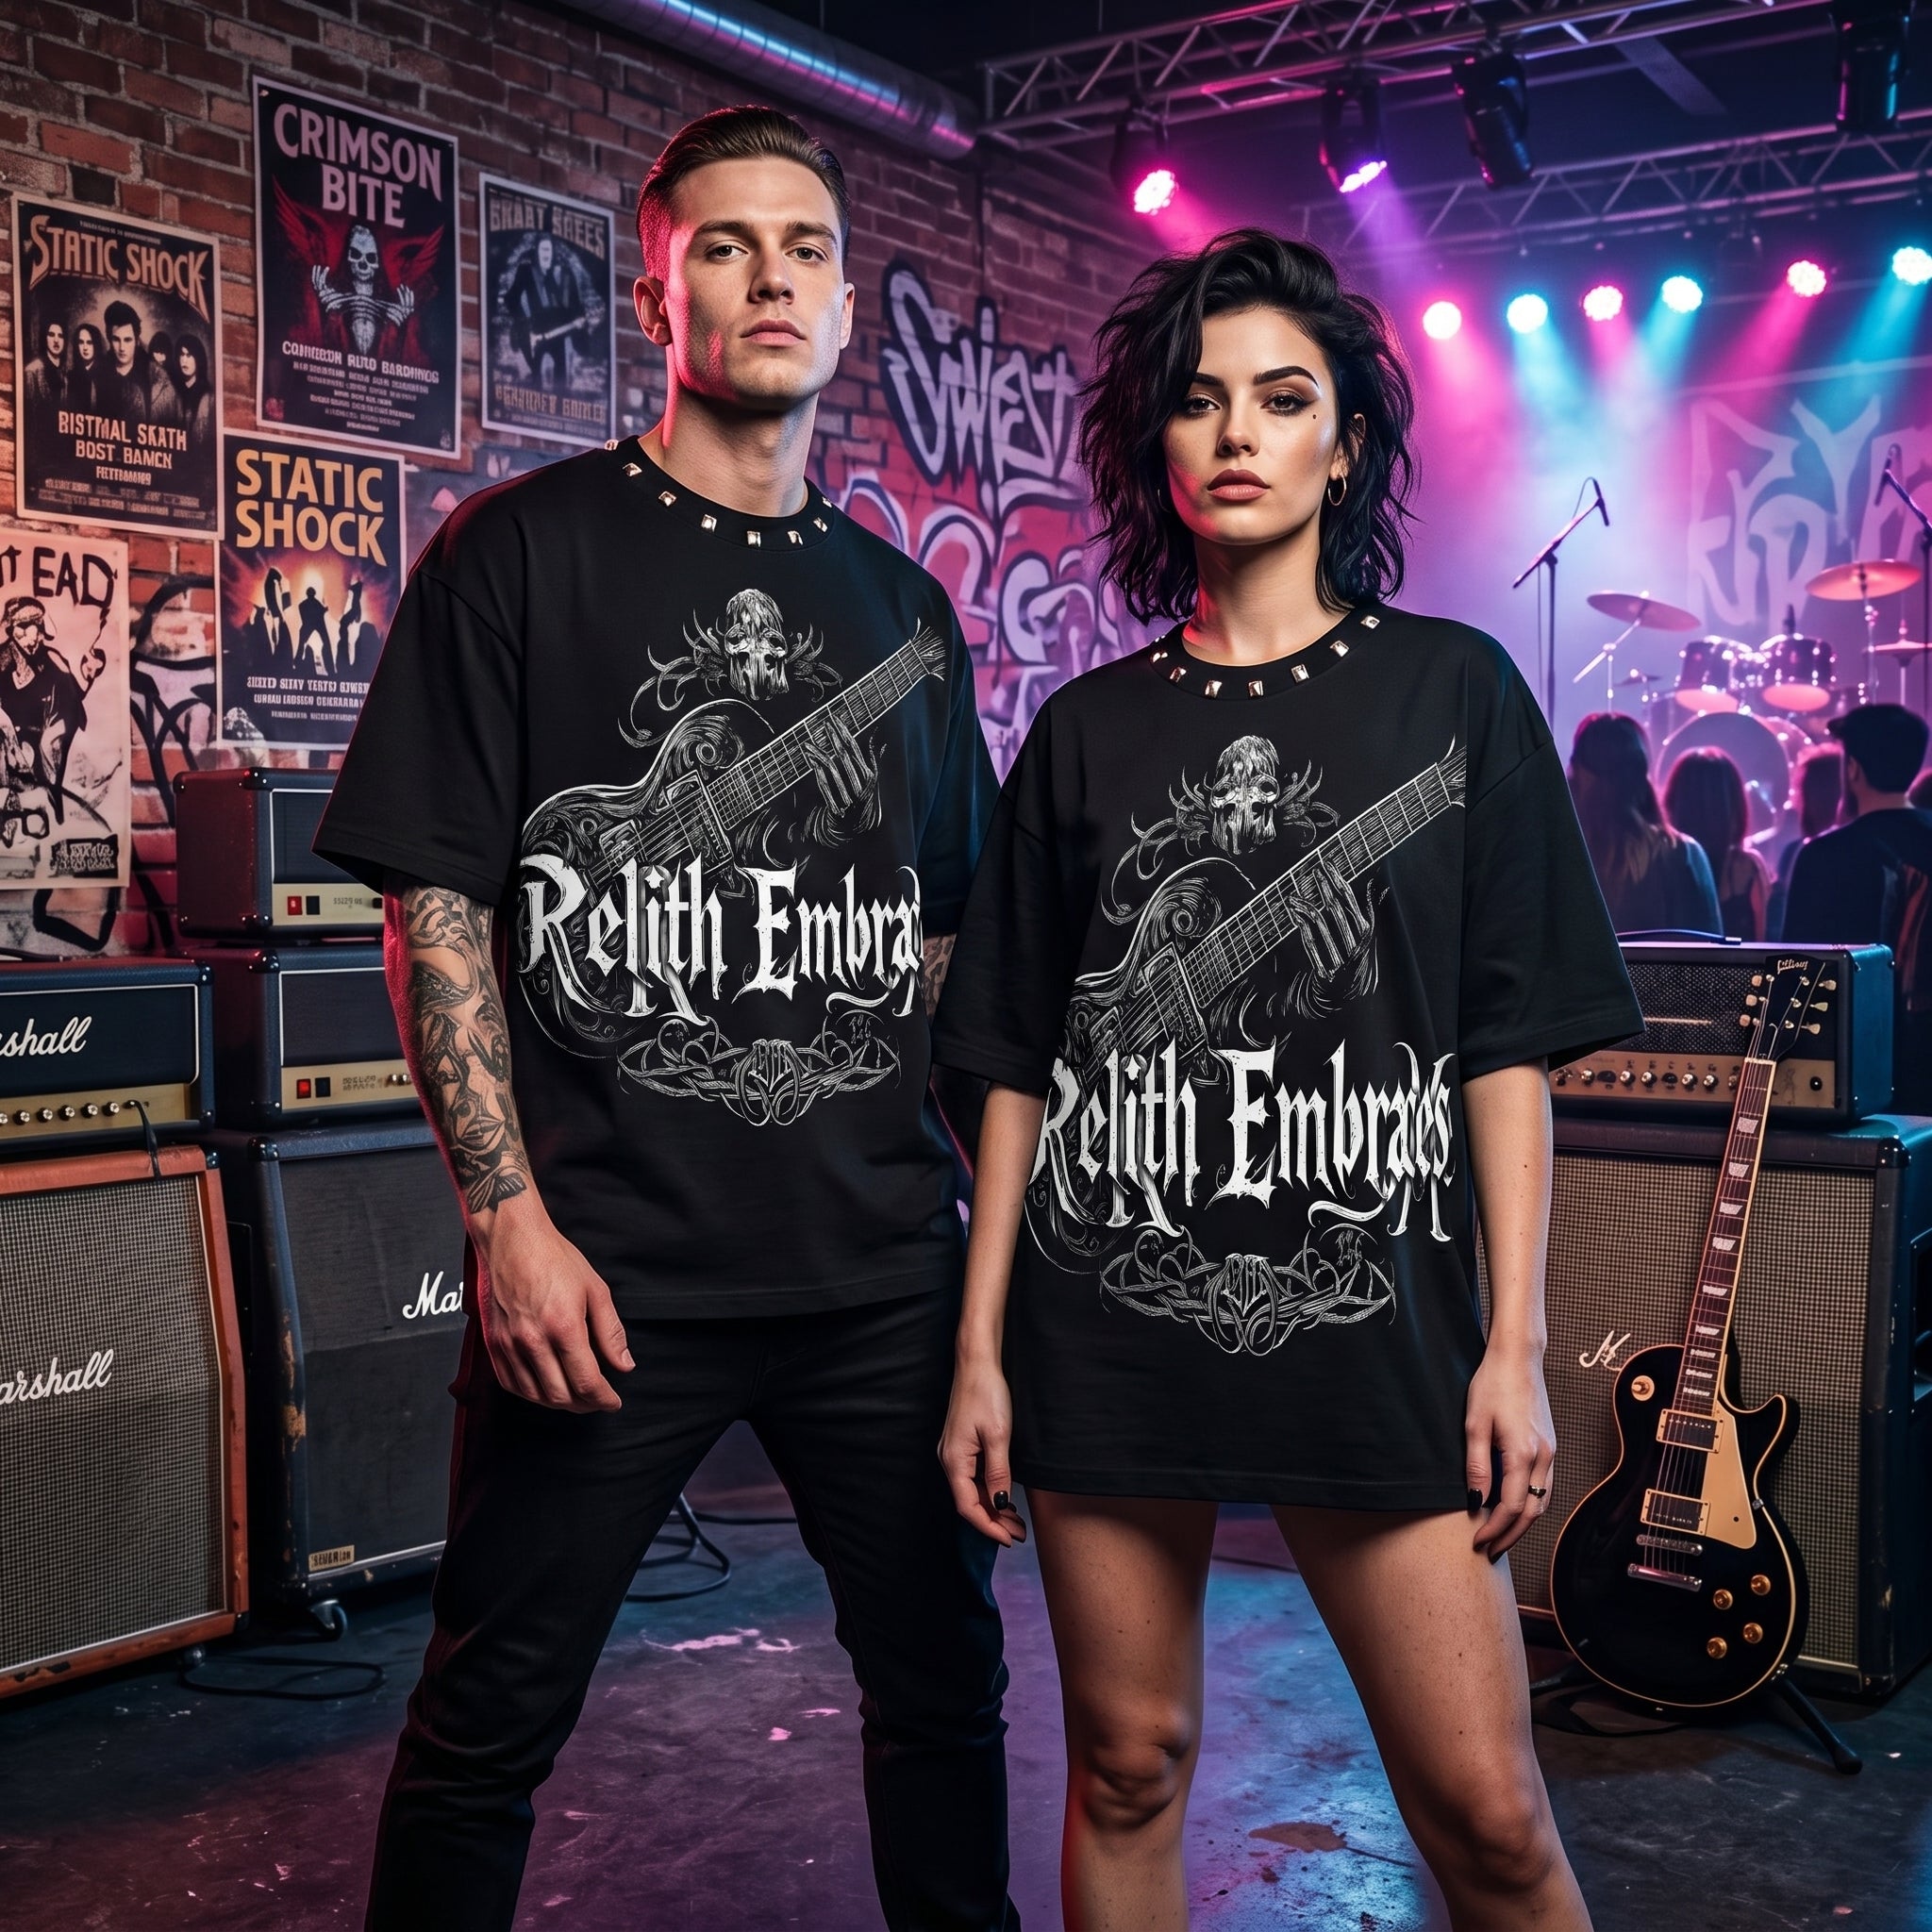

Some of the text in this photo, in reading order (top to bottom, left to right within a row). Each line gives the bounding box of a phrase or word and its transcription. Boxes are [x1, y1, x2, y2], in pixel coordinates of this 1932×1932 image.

[274, 103, 442, 202] CRIMSON
[322, 163, 406, 228] BITE
[29, 214, 210, 324] STATIC SHOCK
[236, 448, 384, 513] STATIC
[236, 499, 388, 567] SHOCK
